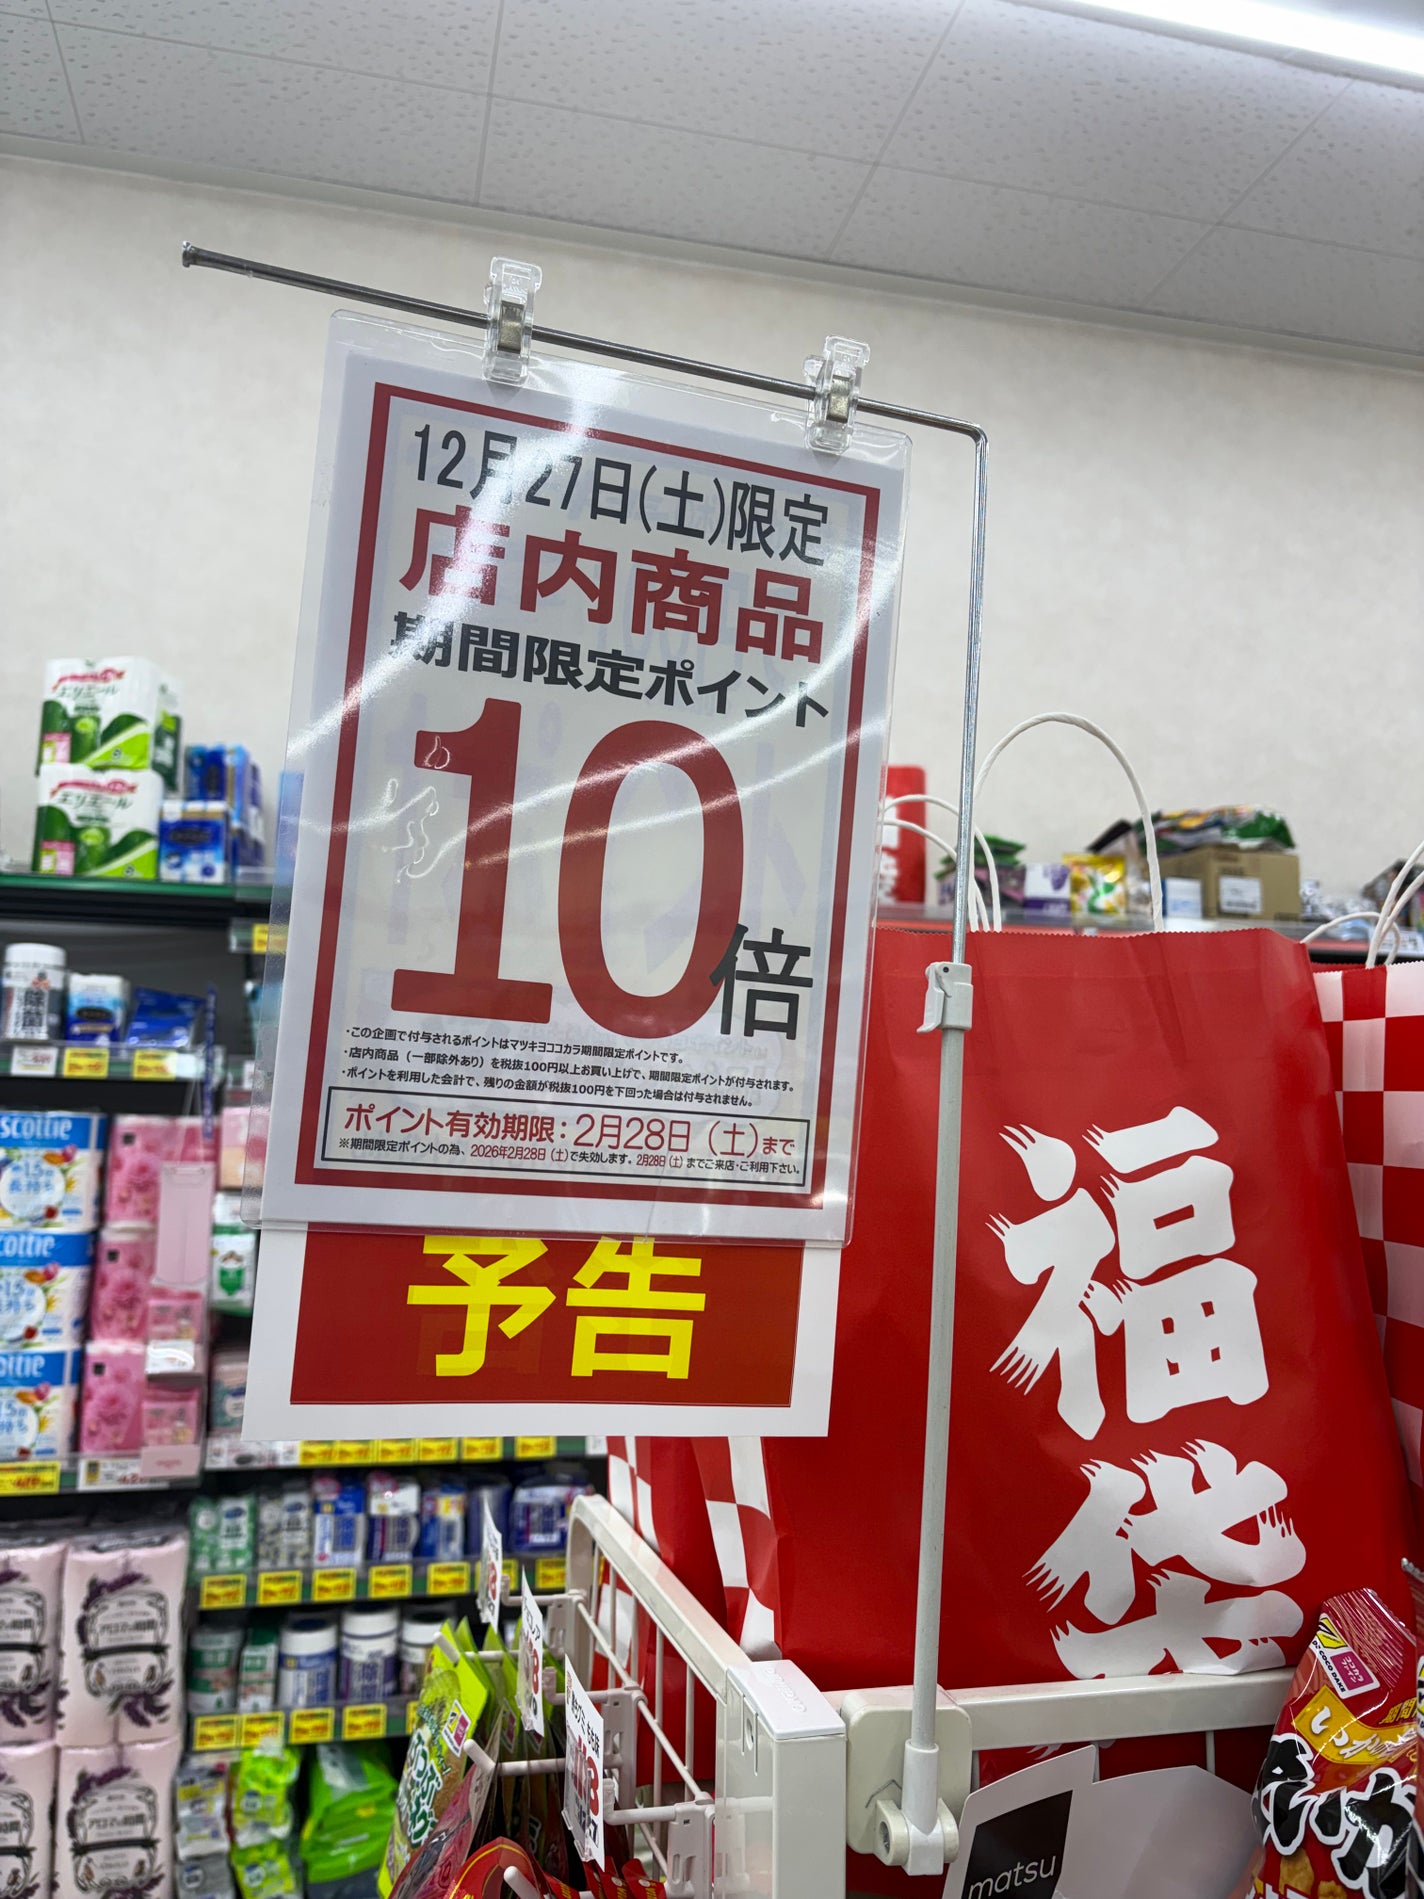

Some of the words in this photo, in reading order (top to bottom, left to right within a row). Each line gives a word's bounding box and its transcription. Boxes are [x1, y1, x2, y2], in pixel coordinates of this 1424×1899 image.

[414, 424, 828, 566] 12月27日(土)限定
[399, 505, 825, 663] 店内商品
[390, 611, 829, 728] 期間限定ポイント
[407, 1235, 706, 1380] 予告
[1319, 1650, 1334, 1672] COCO
[1331, 1671, 1346, 1693] DAKE
[968, 1855, 1057, 1899] matsu
